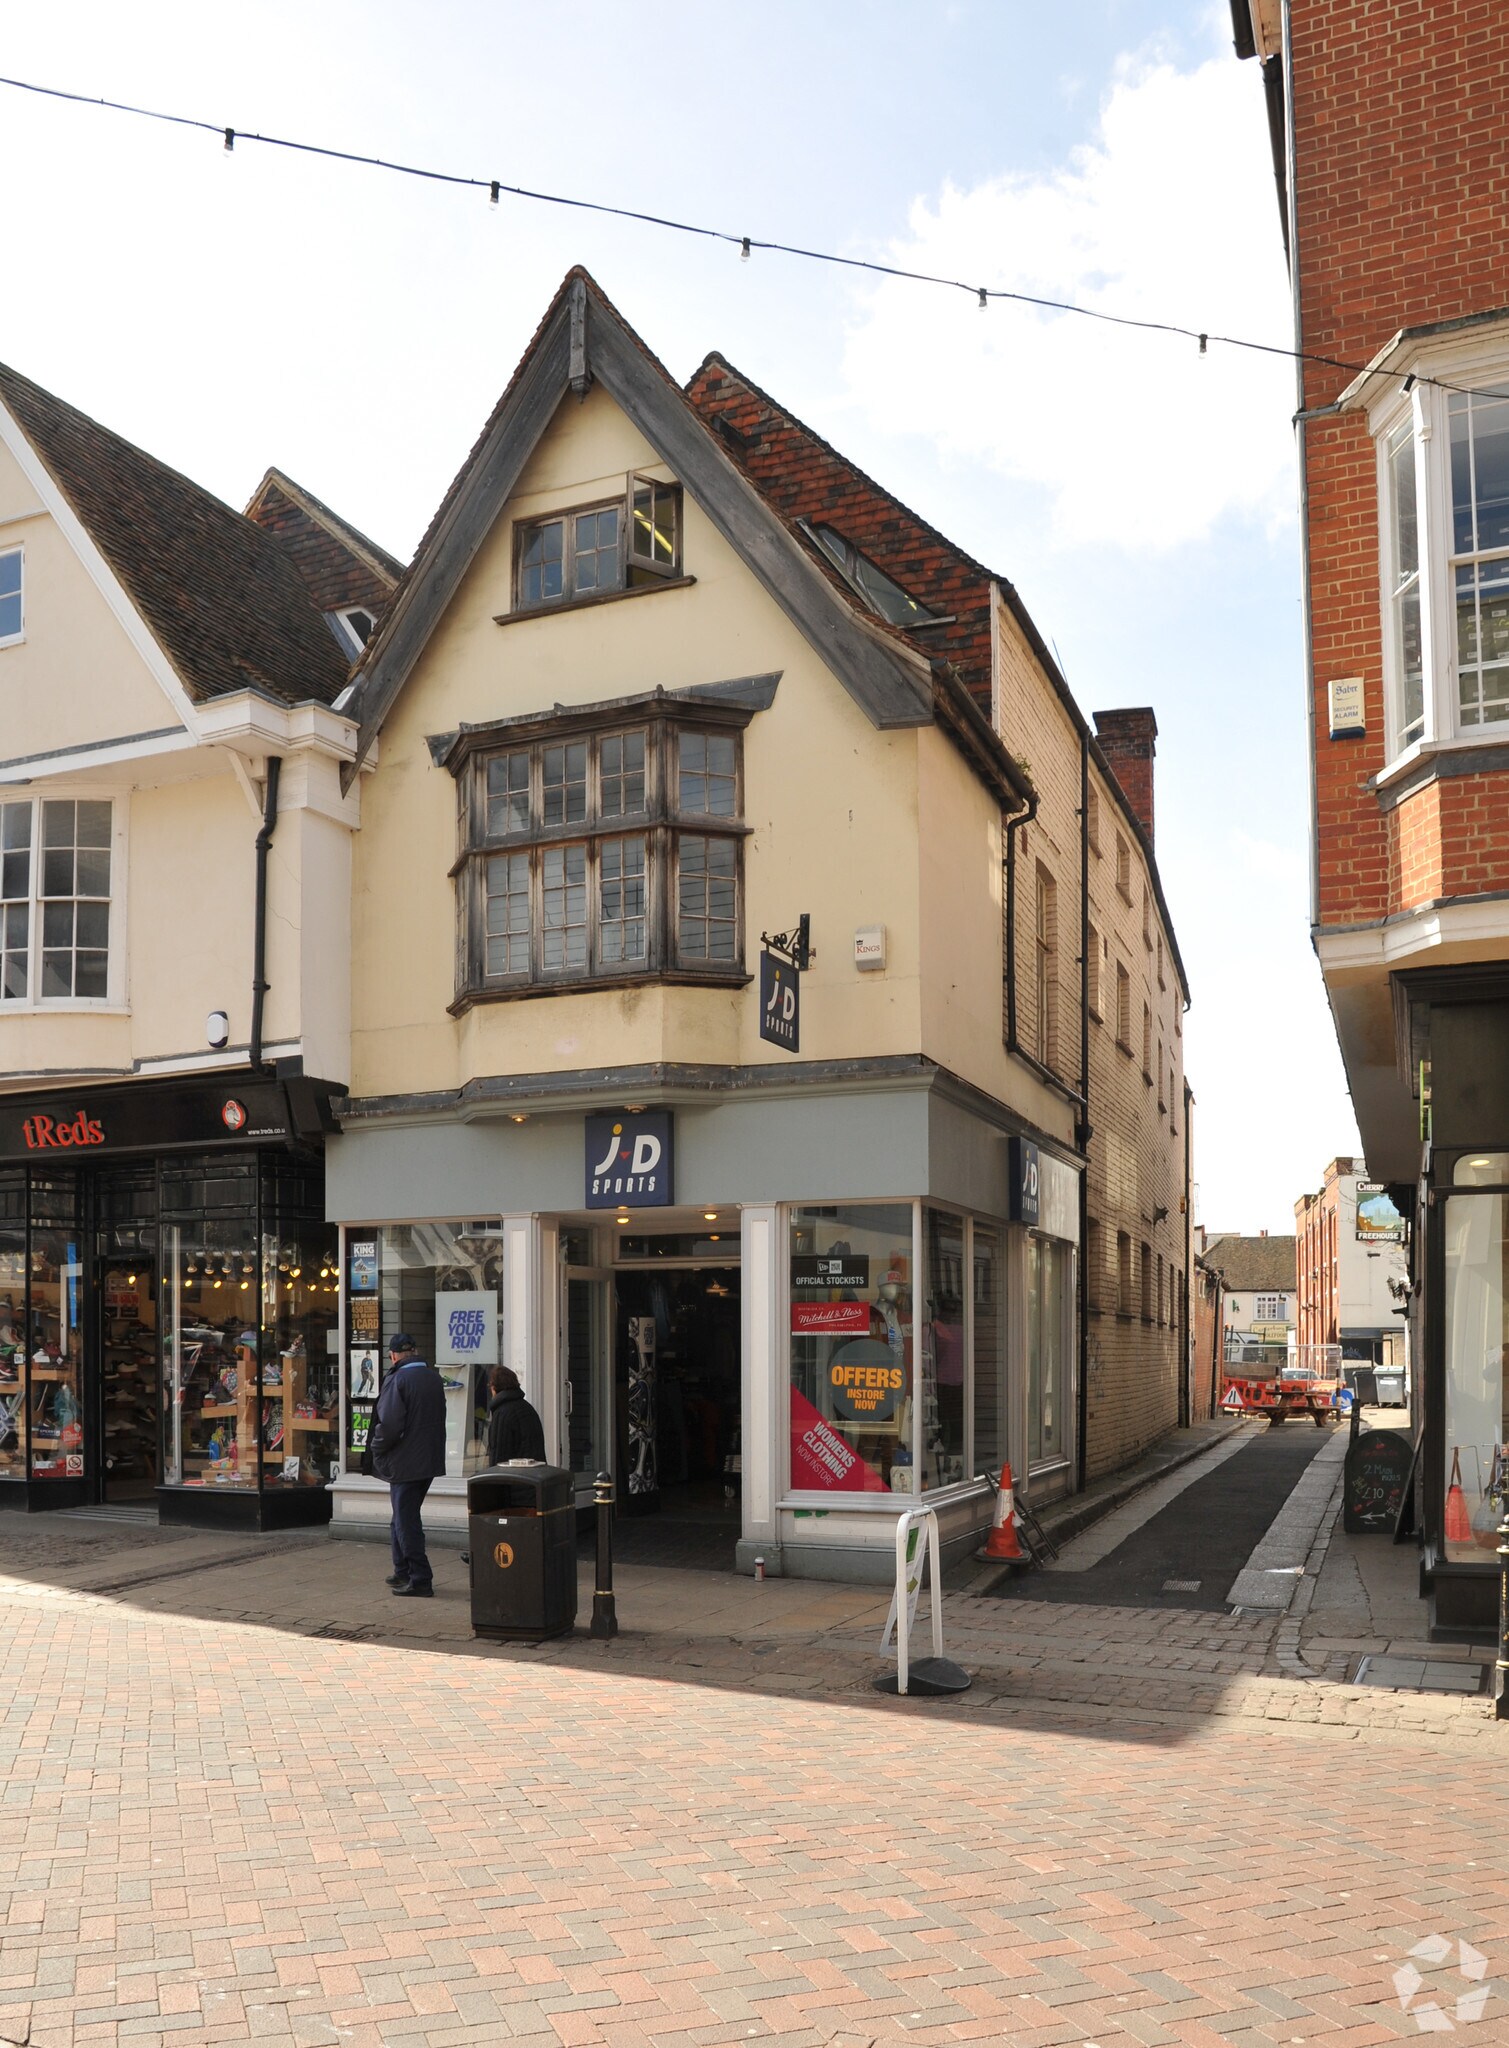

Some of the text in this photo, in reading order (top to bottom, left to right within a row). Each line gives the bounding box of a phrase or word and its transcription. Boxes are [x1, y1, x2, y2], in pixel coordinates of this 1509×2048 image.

[1334, 711, 1359, 719] ALARM
[766, 1014, 793, 1039] SPORTS
[22, 1110, 105, 1149] tReds
[592, 1176, 656, 1195] SPORTS
[1358, 1232, 1399, 1240] FREEHOUSE
[353, 1246, 375, 1255] KING
[795, 1276, 865, 1285] OFFICIAL STOCKISTS
[449, 1310, 485, 1323] FREE
[798, 1307, 864, 1324] Mitchell & Ness
[357, 1319, 379, 1330] CARD
[448, 1323, 486, 1336] YOUR
[451, 1336, 482, 1349] RUN
[831, 1365, 903, 1389] OFFERS
[847, 1388, 886, 1400] INSTORE
[854, 1400, 877, 1410] NOW
[353, 1413, 361, 1429] 2
[813, 1421, 856, 1468] WOMENS
[802, 1431, 848, 1480] CLOTHING
[796, 1445, 835, 1487] NOW INSTORE
[1363, 1464, 1372, 1474] 2
[1361, 1487, 1384, 1499] £10
